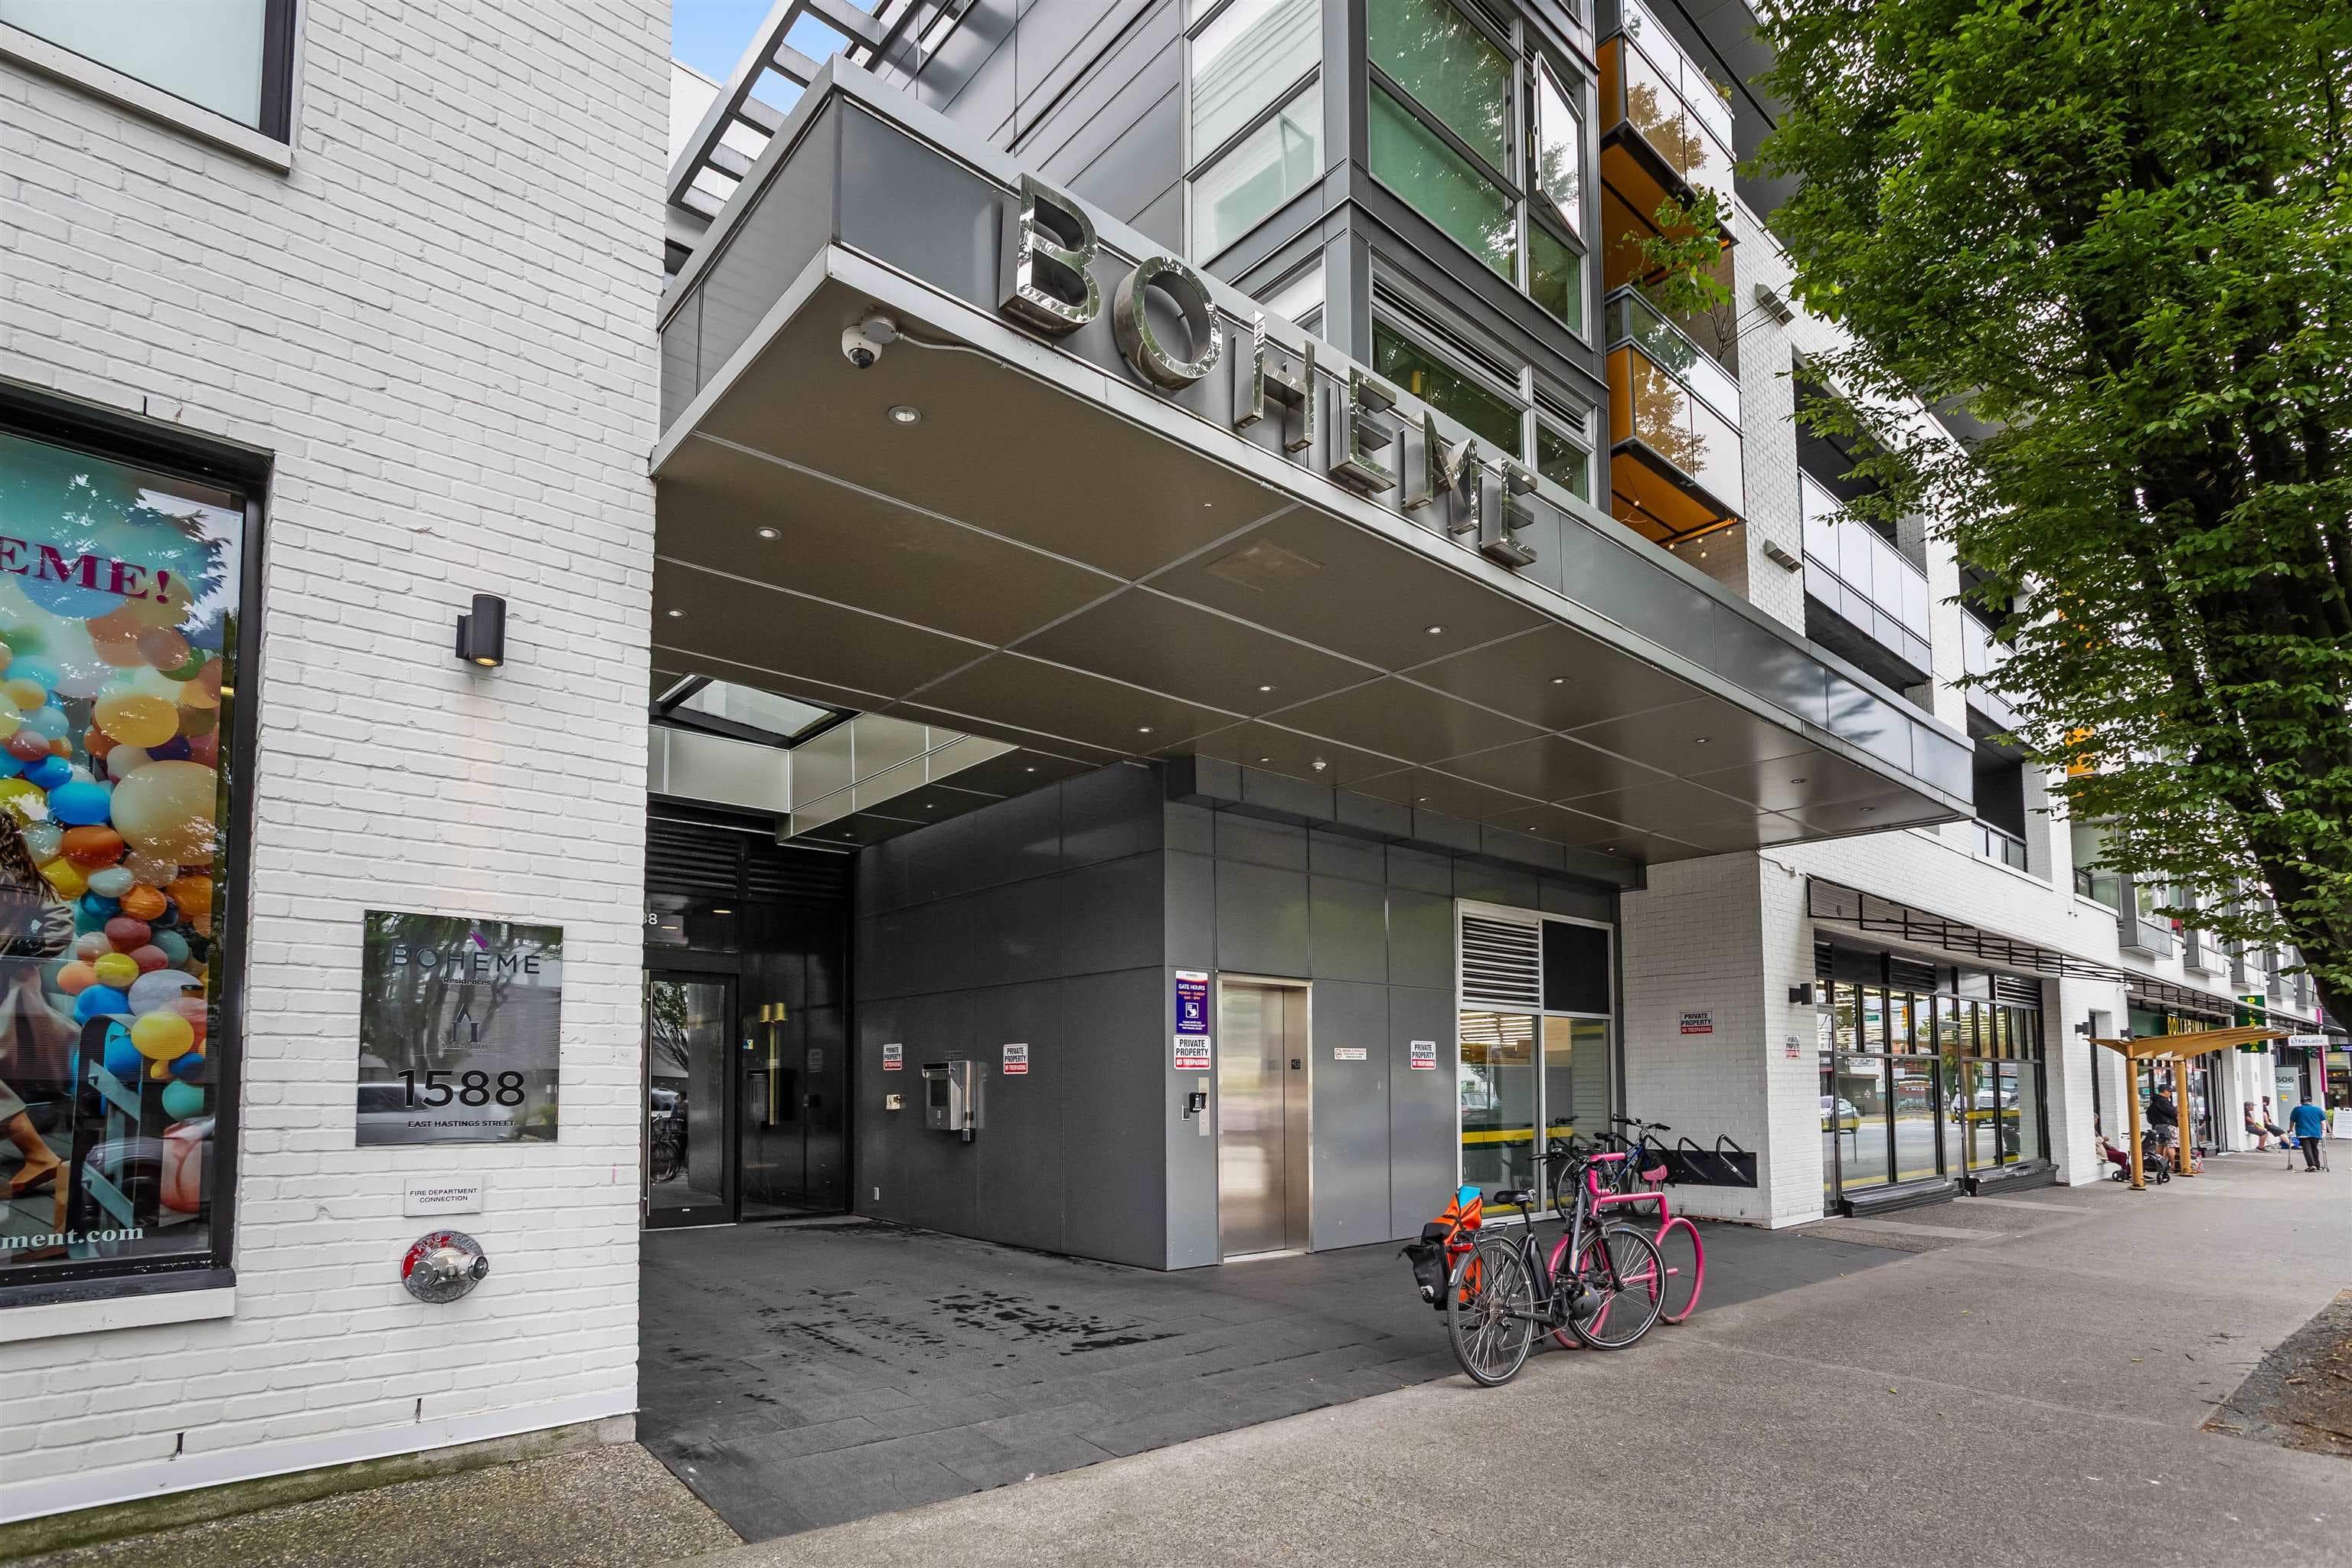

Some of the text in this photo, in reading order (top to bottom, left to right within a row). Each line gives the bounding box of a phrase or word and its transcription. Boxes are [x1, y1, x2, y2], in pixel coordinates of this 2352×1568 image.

[999, 173, 1538, 568] BOHEME
[0, 537, 170, 604] EME!
[1176, 1048, 1208, 1057] PROPERTY
[1179, 1039, 1205, 1047] PRIVATE
[397, 1069, 526, 1107] 1588
[0, 1227, 144, 1250] ment.com
